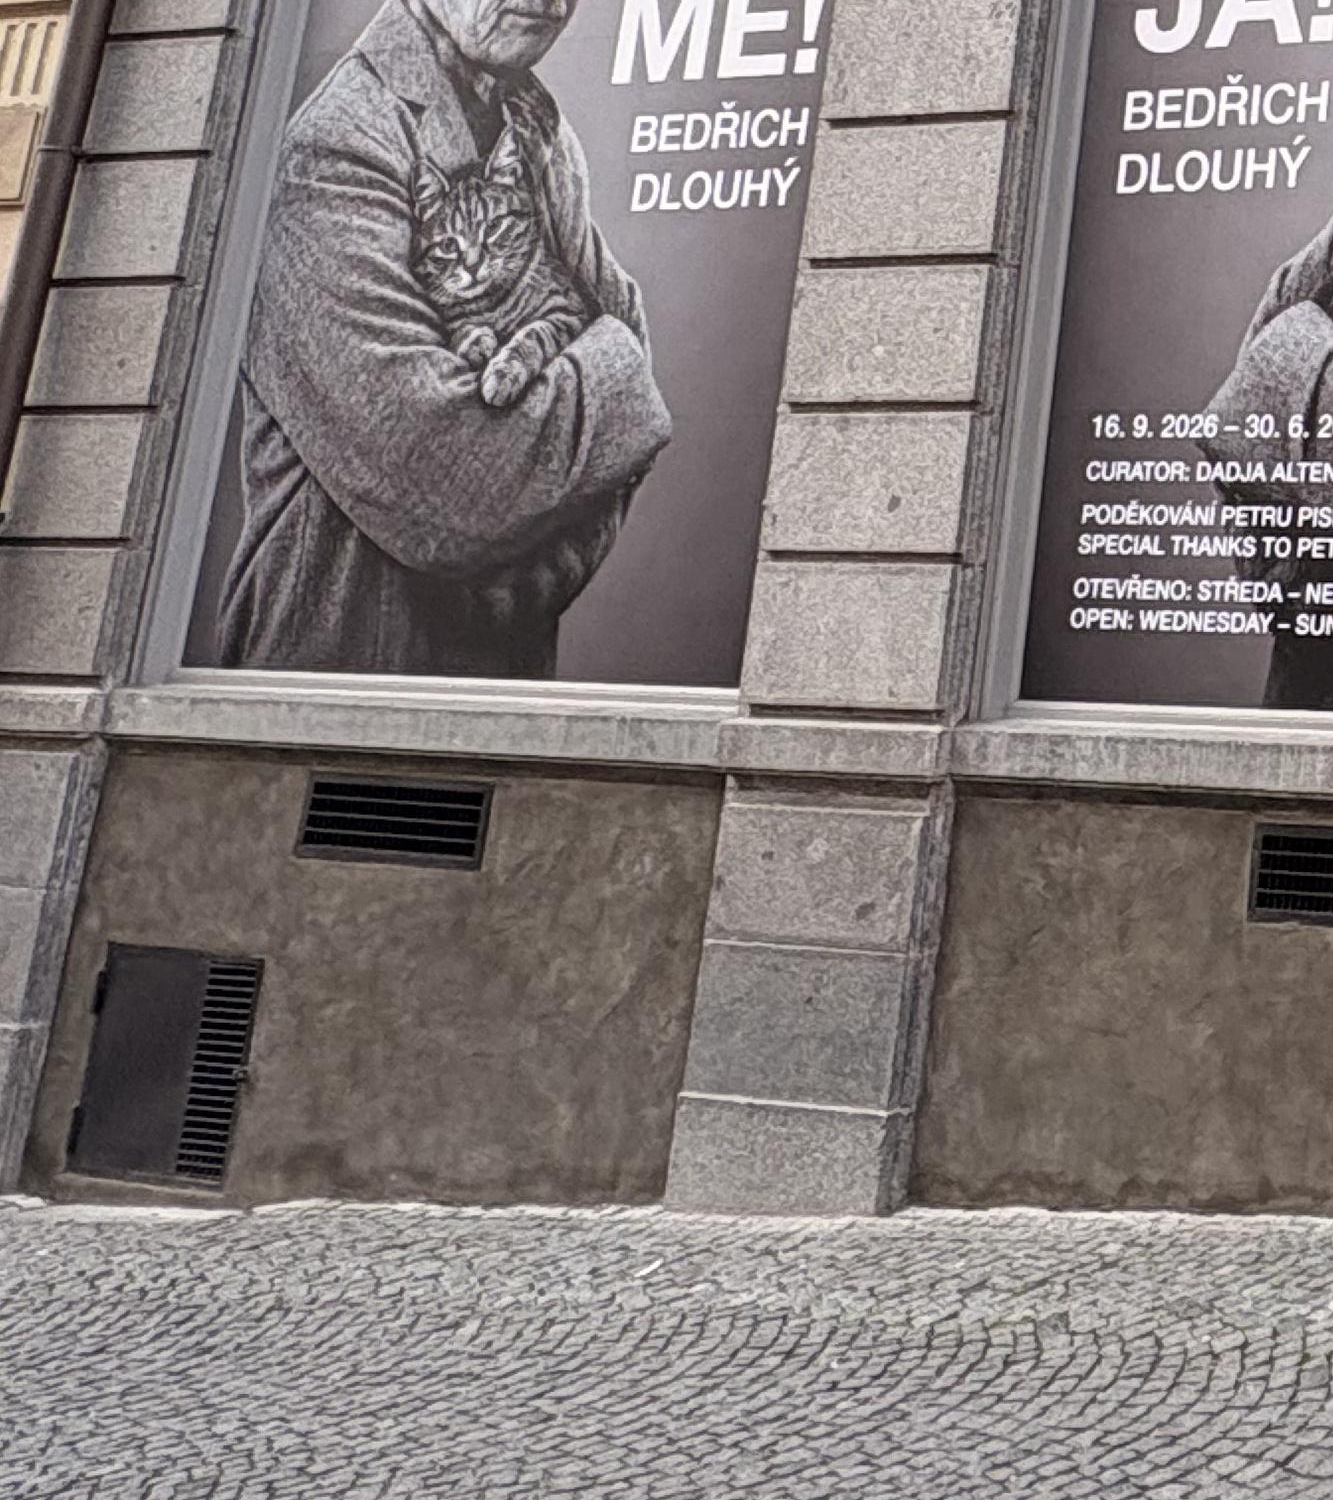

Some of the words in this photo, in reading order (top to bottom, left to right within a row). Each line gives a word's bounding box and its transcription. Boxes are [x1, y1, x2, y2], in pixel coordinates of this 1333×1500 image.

[1122, 75, 1331, 131] BEDŘICH
[629, 101, 810, 154] BEDŘICH
[1115, 136, 1312, 195] DLOUHÝ
[629, 156, 802, 212] DLOUHÝ
[1091, 413, 1127, 439] 16.
[1132, 413, 1155, 439] 9.
[1160, 413, 1220, 439] 2026
[1244, 413, 1281, 439] 30.
[1287, 413, 1310, 439] 6.
[1085, 460, 1191, 483] CURATOR:
[1196, 461, 1267, 484] DADJA
[1080, 500, 1218, 526] PODĚKOVÁNÍ
[1220, 504, 1293, 528] PETRU
[1077, 532, 1166, 556] SPECIAL
[1170, 535, 1257, 558] THANKS
[1261, 536, 1292, 559] TO
[1073, 574, 1193, 601] OTEVŘENO:
[1197, 576, 1284, 604] STŘEDA
[1069, 607, 1134, 631] OPEN:
[1139, 610, 1276, 634] WEDNESDAY
